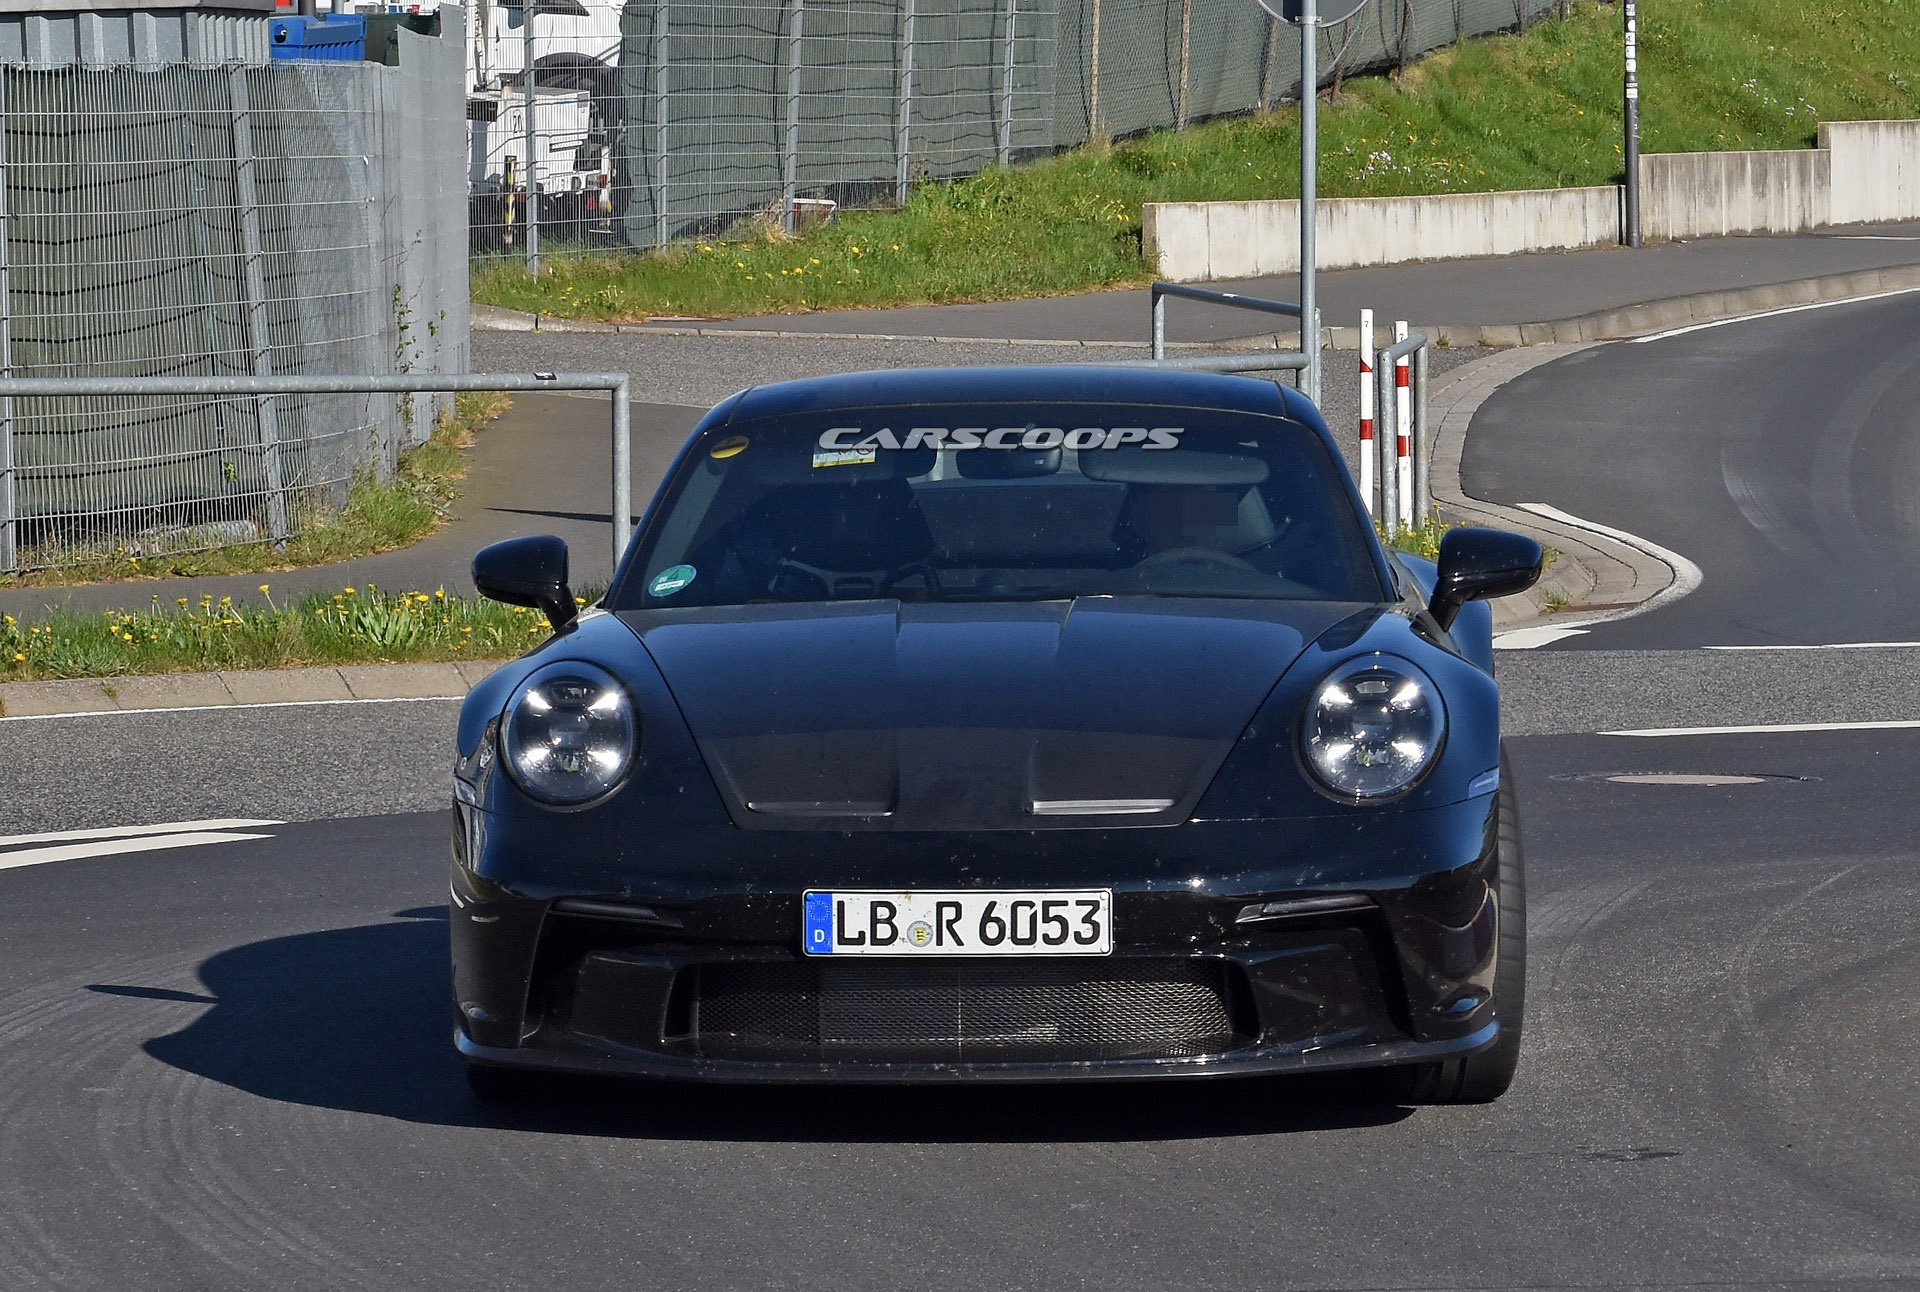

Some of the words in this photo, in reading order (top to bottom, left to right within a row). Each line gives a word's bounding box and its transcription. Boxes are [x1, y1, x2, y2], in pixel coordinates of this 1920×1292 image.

[814, 929, 825, 943] D
[836, 900, 899, 946] LB
[935, 900, 965, 947] R
[978, 900, 1101, 947] 6053
